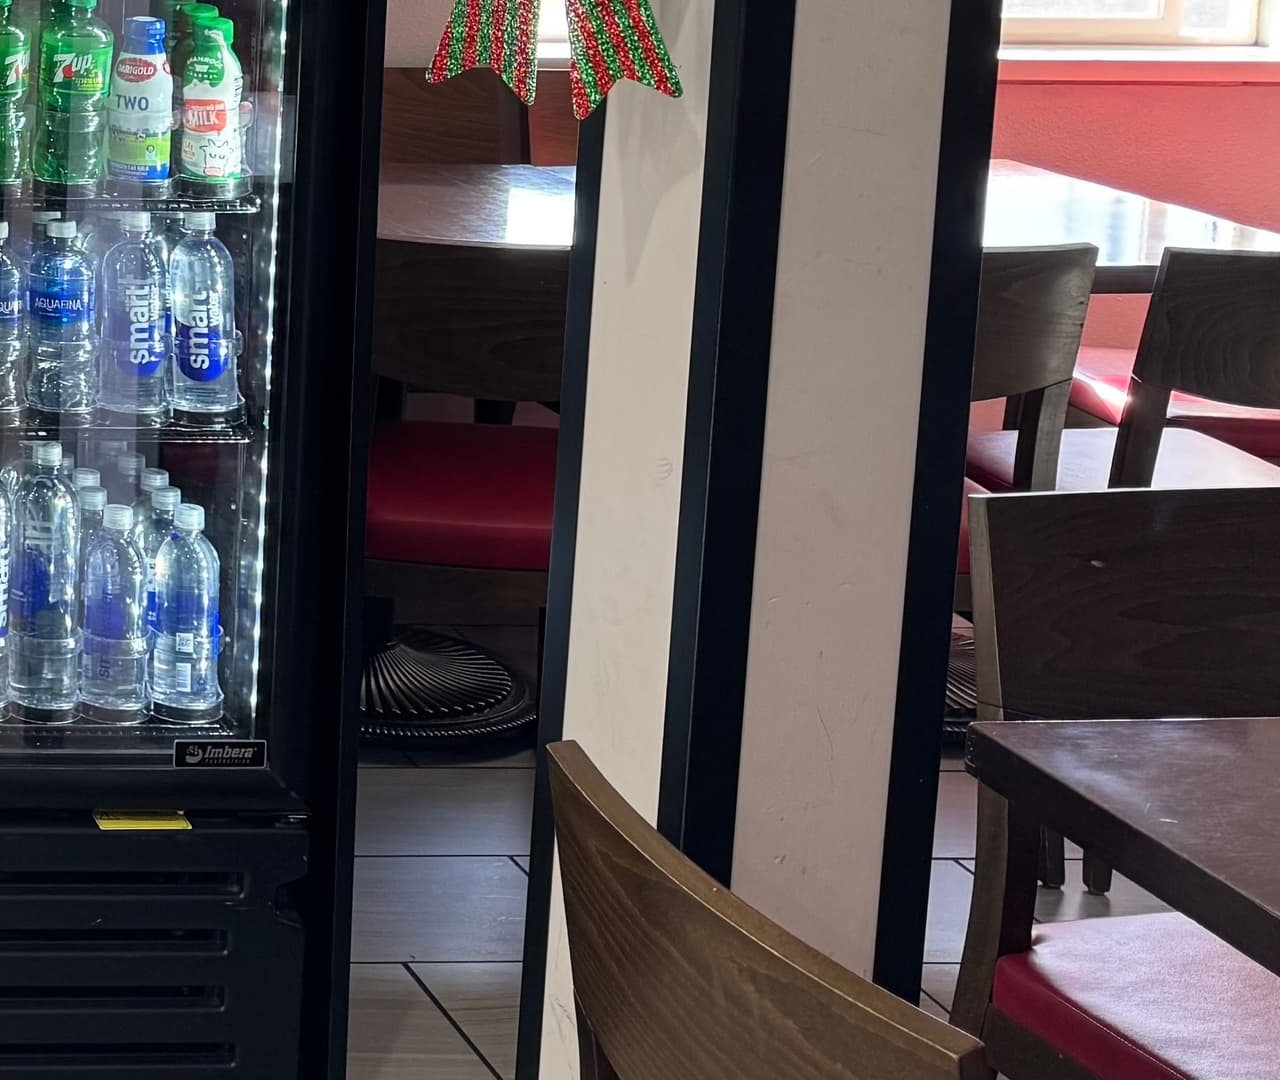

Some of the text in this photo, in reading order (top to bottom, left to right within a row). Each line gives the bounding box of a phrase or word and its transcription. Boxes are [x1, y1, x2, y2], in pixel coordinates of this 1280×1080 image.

[117, 65, 154, 76] DARIGOLD
[115, 94, 150, 112] TWO
[188, 110, 220, 126] MILK
[35, 297, 83, 311] AQUAFINA
[204, 745, 254, 758] Imbera
